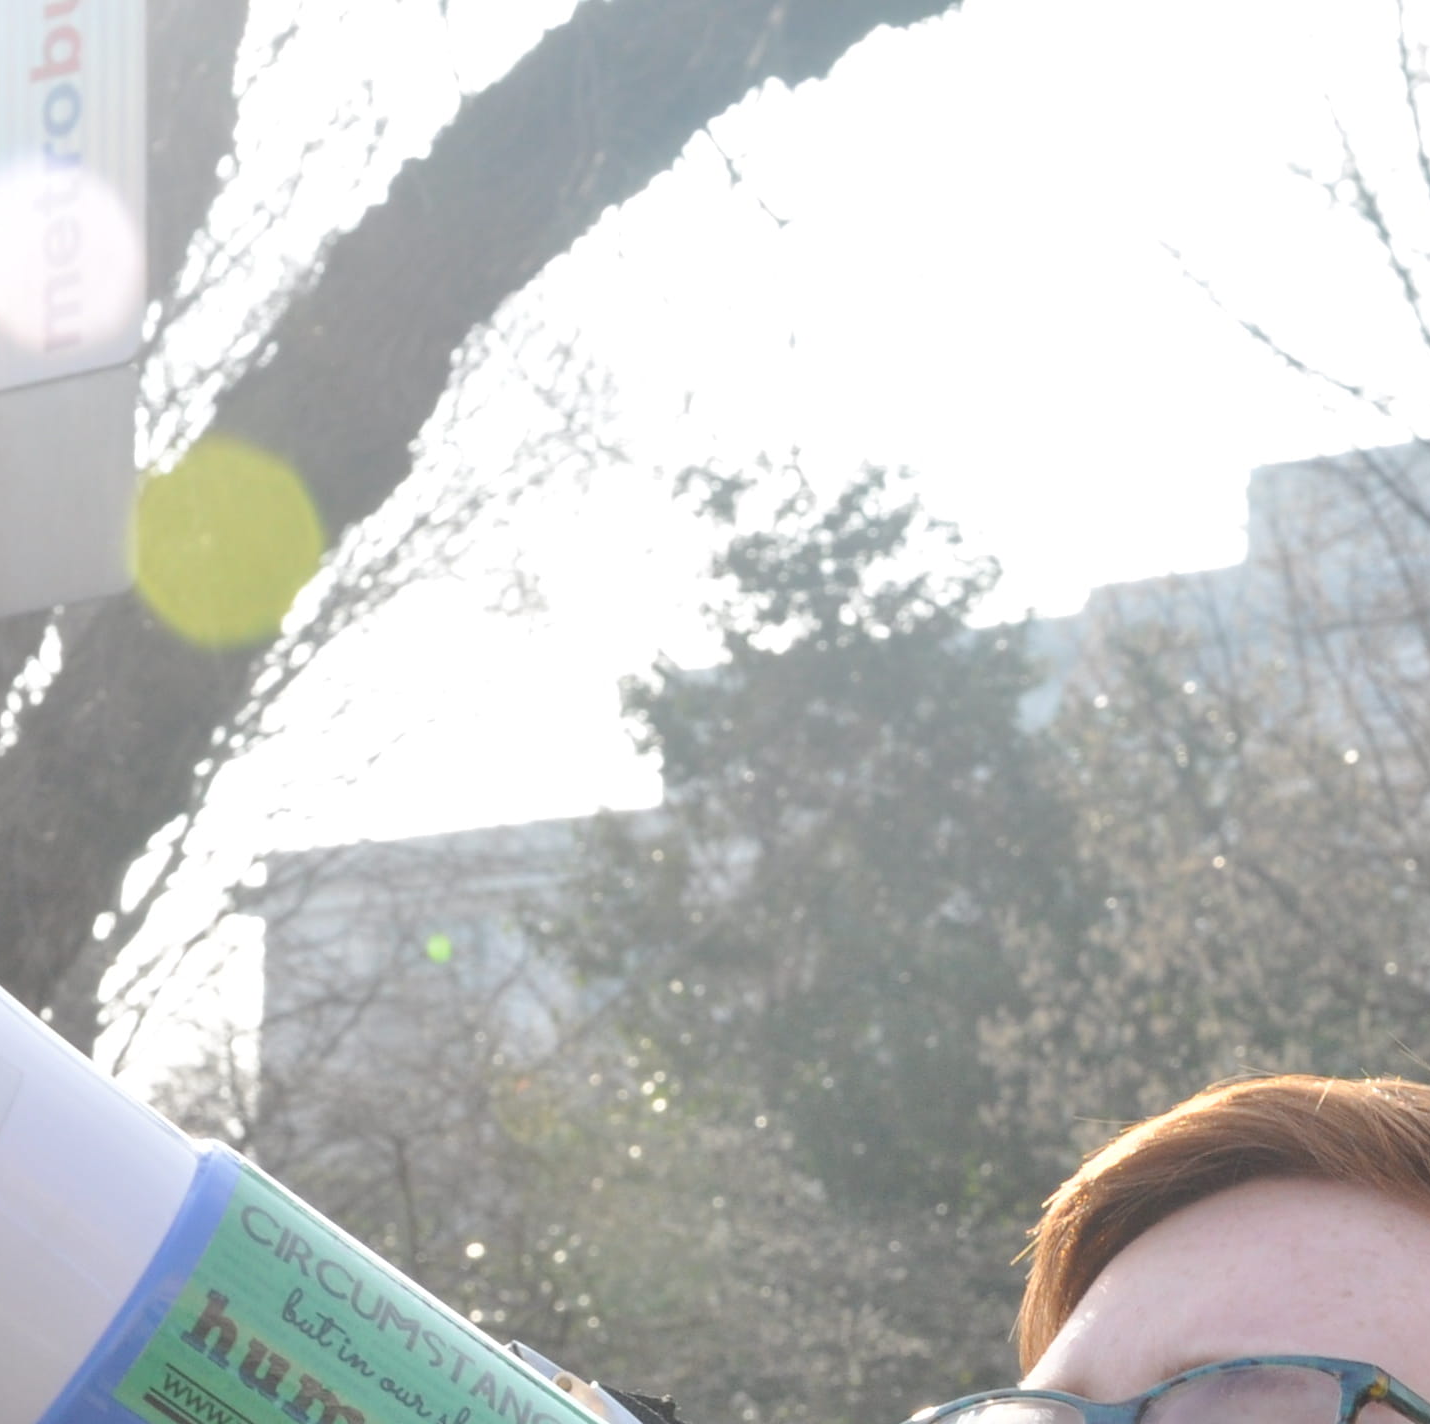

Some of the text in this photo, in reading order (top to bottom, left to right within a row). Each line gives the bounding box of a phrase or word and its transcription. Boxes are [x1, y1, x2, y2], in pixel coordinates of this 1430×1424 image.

[282, 1288, 346, 1348] but
[338, 1337, 375, 1377] in
[380, 1377, 432, 1417] our
